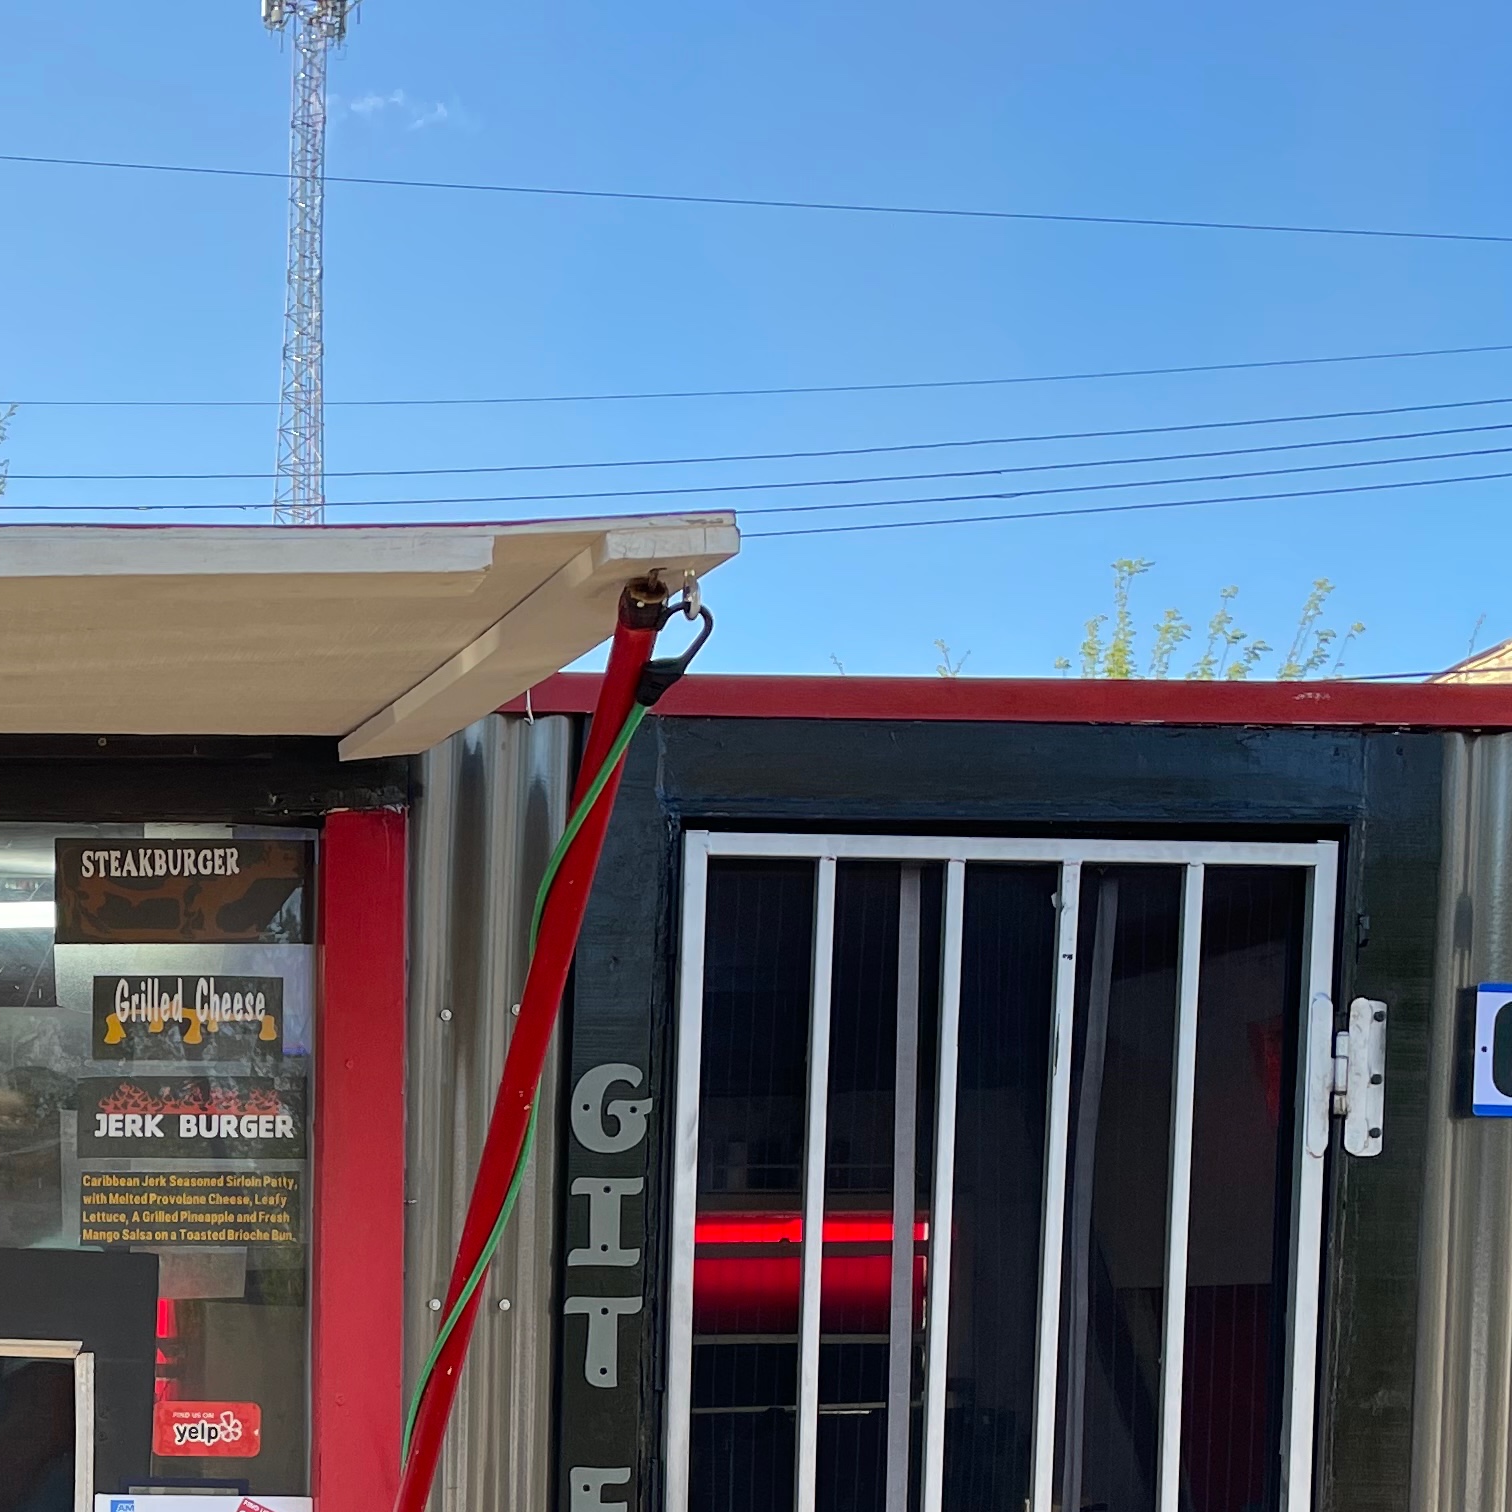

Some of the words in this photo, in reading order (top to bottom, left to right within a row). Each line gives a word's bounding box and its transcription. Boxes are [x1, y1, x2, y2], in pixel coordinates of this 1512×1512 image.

[81, 847, 240, 878] STEAKBURGER
[114, 977, 183, 1023] Grilled
[195, 976, 266, 1022] Cheese
[94, 1113, 164, 1138] JERK
[179, 1114, 294, 1139] BURGER
[82, 1174, 139, 1187] Caribbean
[141, 1175, 167, 1187] Jerk
[169, 1175, 224, 1187] Seasoned
[225, 1175, 262, 1188] Sirloin
[263, 1175, 298, 1190] Patty,
[82, 1193, 108, 1205] with
[108, 1193, 147, 1205] Melted
[208, 1193, 252, 1207] Cheese,
[254, 1194, 287, 1208] Leafy
[82, 1211, 129, 1225] Lettuce,
[131, 1211, 139, 1223] A
[142, 1211, 179, 1223] Grilled
[180, 1211, 235, 1226] Pineapple
[236, 1211, 257, 1223] and
[258, 1211, 290, 1223] Fresh
[563, 1062, 653, 1388] GIT
[82, 1229, 120, 1243] Mango
[121, 1229, 153, 1241] Salsa
[154, 1231, 168, 1241] on
[170, 1231, 177, 1241] a
[178, 1229, 229, 1241] Toasted
[227, 1229, 271, 1241] Brioche
[172, 1411, 191, 1419] FIND
[175, 1422, 219, 1443] yelp
